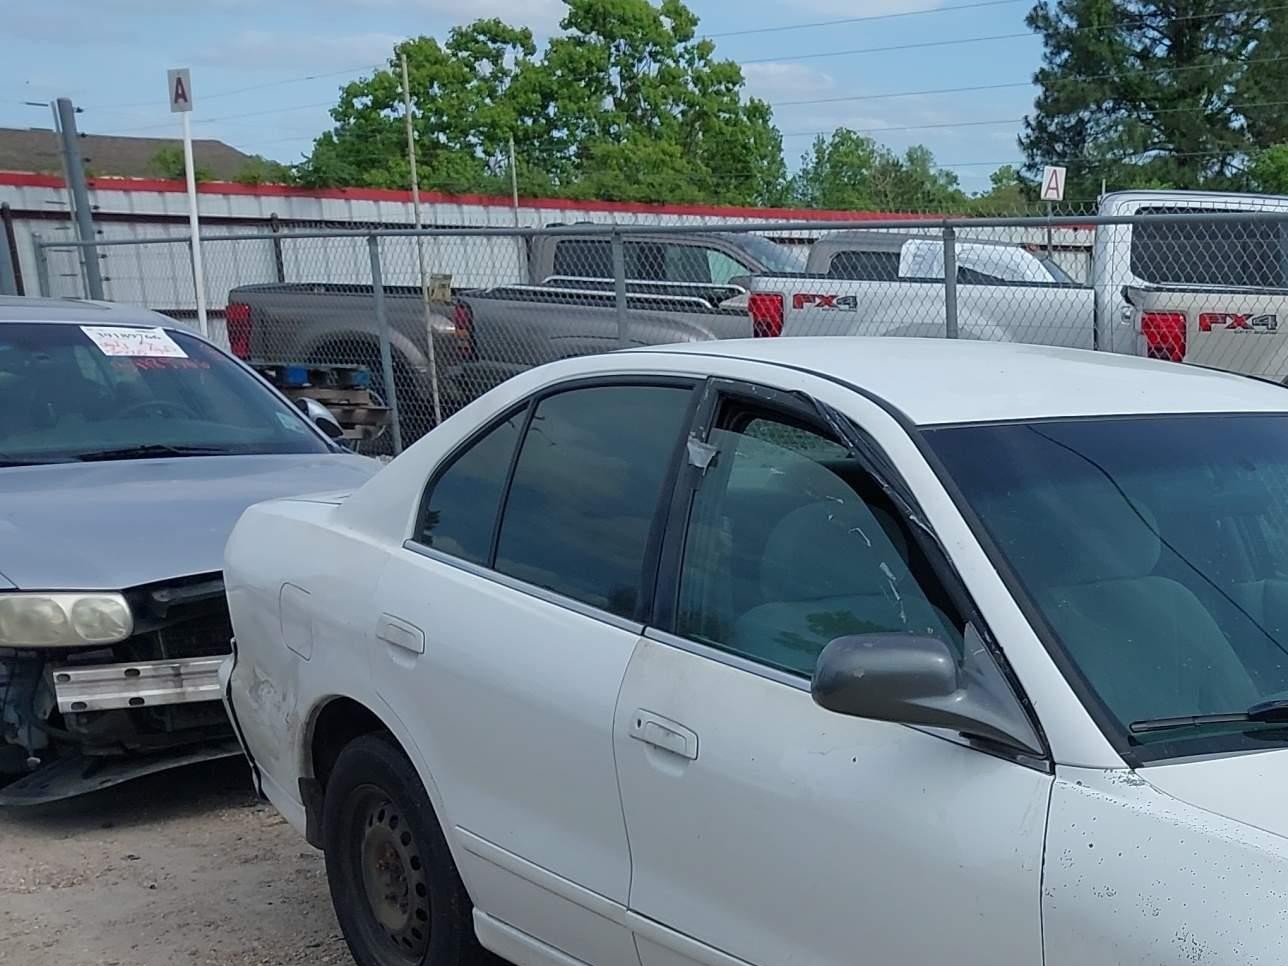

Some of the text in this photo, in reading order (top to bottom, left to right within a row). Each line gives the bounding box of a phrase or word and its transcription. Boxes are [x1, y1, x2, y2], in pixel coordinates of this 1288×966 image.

[174, 76, 189, 104] A
[1044, 169, 1060, 198] A
[792, 293, 858, 310] FX4
[1199, 312, 1278, 332] FX4
